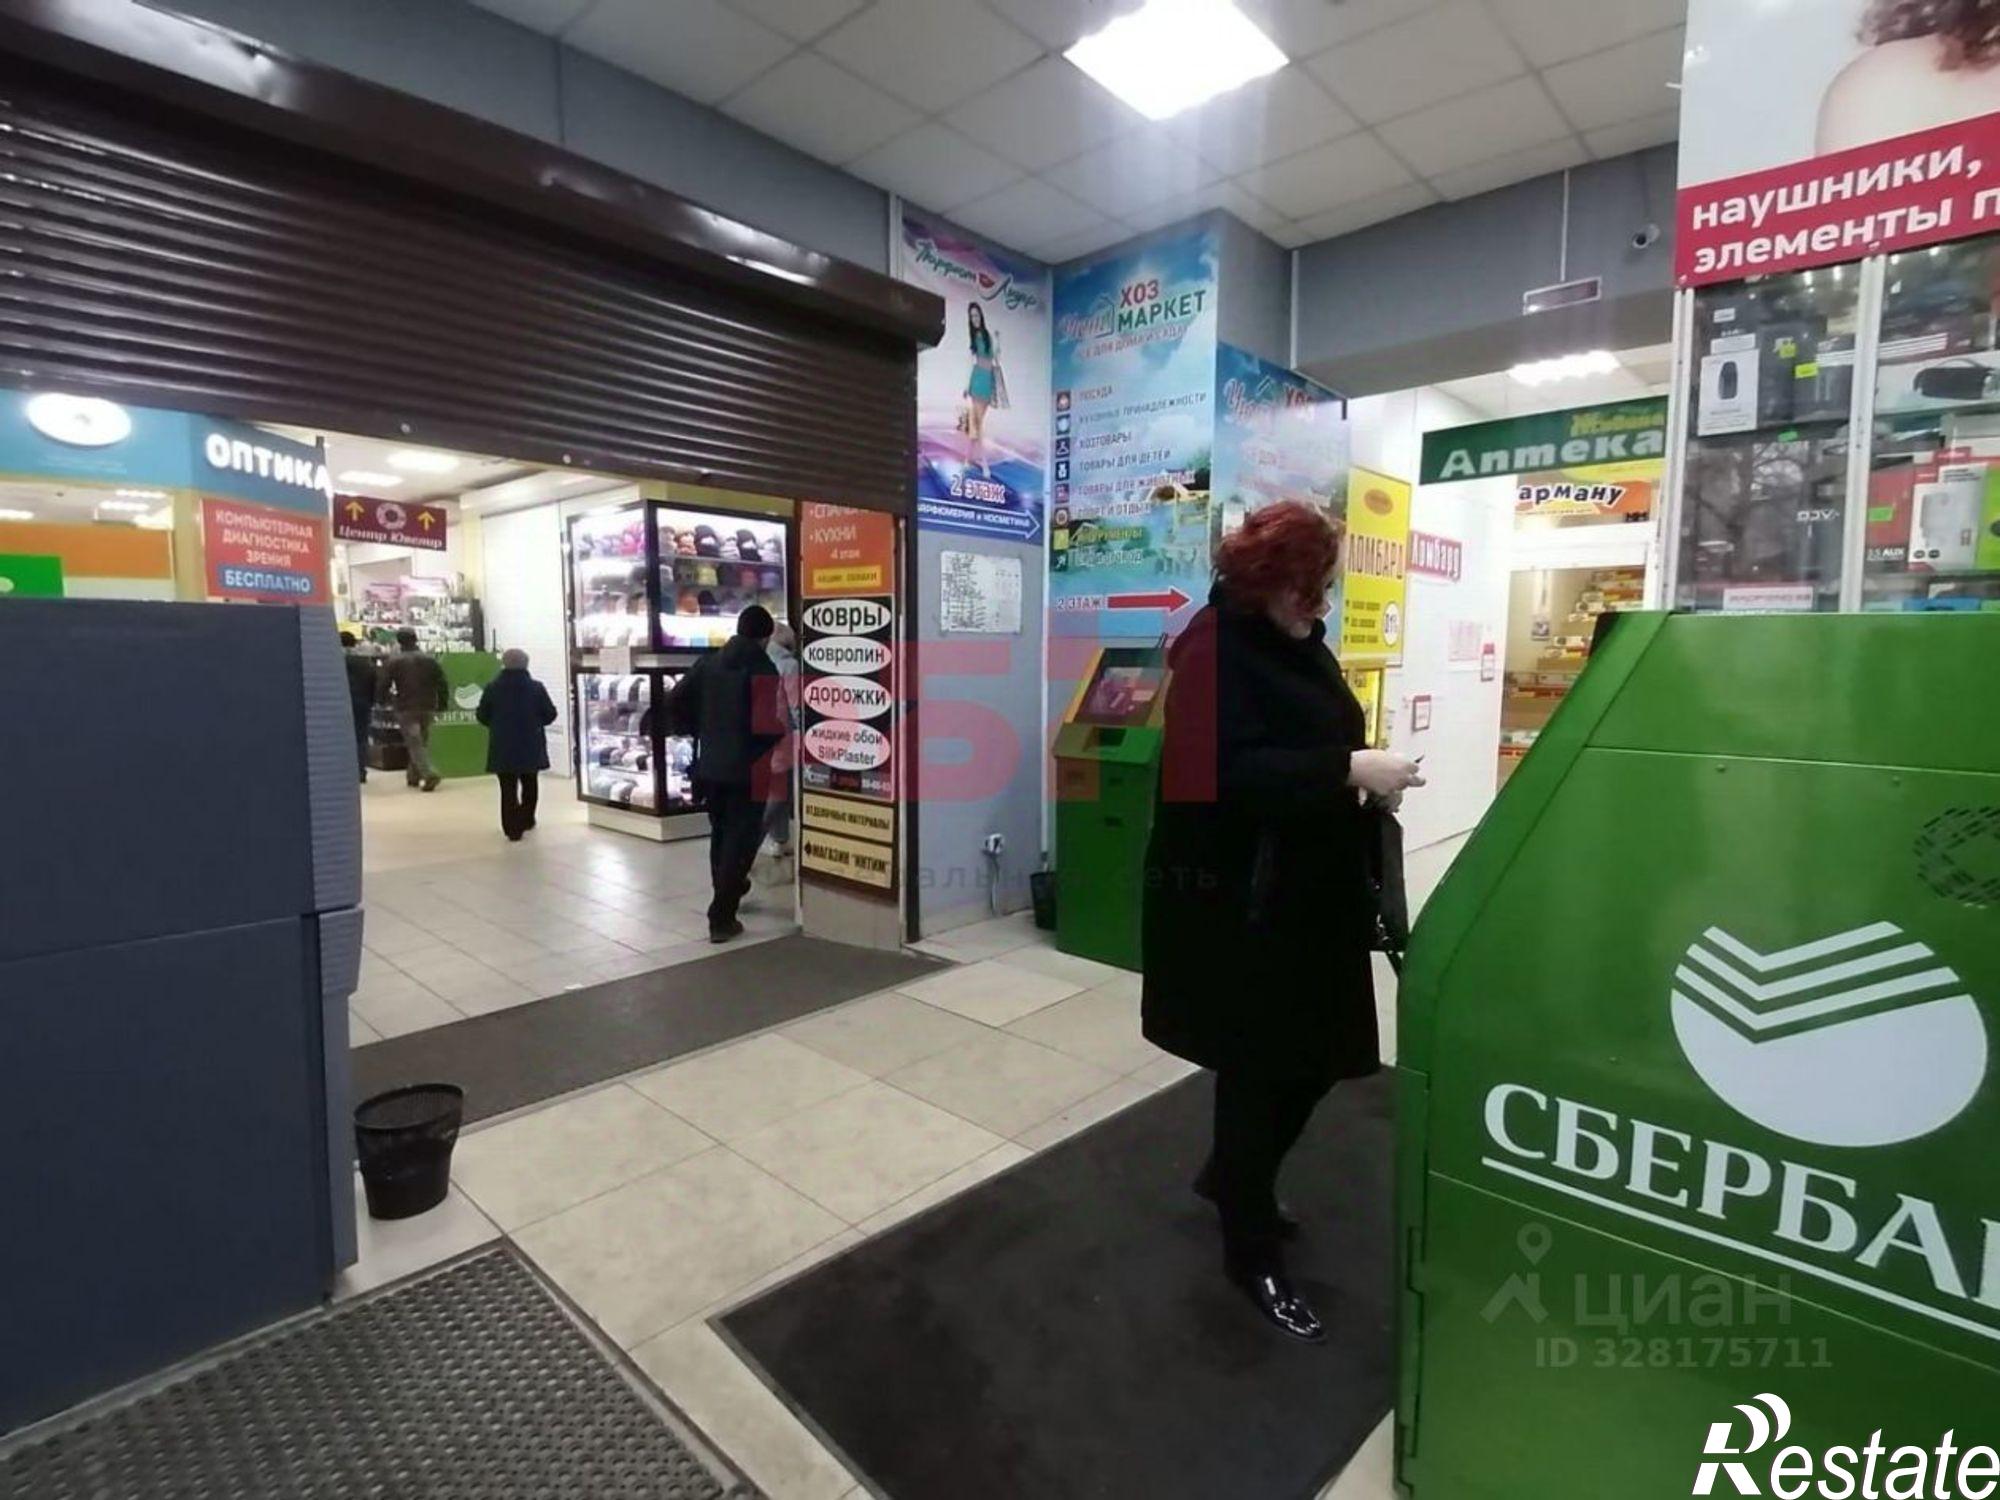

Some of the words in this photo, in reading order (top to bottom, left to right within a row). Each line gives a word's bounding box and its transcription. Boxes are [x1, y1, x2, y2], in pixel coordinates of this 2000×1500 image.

[1693, 143, 1982, 231] наушники,
[1694, 198, 1953, 274] элементы
[1119, 280, 1160, 308] ХОЗ
[1117, 290, 1207, 331] МАРКЕТ
[205, 433, 331, 497] ОПТИКА
[1438, 430, 1664, 478] Аптека
[1518, 484, 1623, 506] арману
[215, 509, 314, 539] КОМПЬЮТЕРНАЯ
[917, 502, 976, 522] АРФЮМЕРИЯ
[222, 528, 311, 554] ДИАГНОСТИКА
[245, 548, 292, 569] ЗРЕНИЯ
[1348, 533, 1404, 580] ЛОМБАРД
[224, 569, 311, 593] БЕСПЛАТНО
[811, 606, 883, 633] ковры
[808, 647, 886, 667] ковролин
[809, 686, 887, 708] дорожки
[811, 728, 851, 742] жидкие
[853, 729, 883, 745] обои
